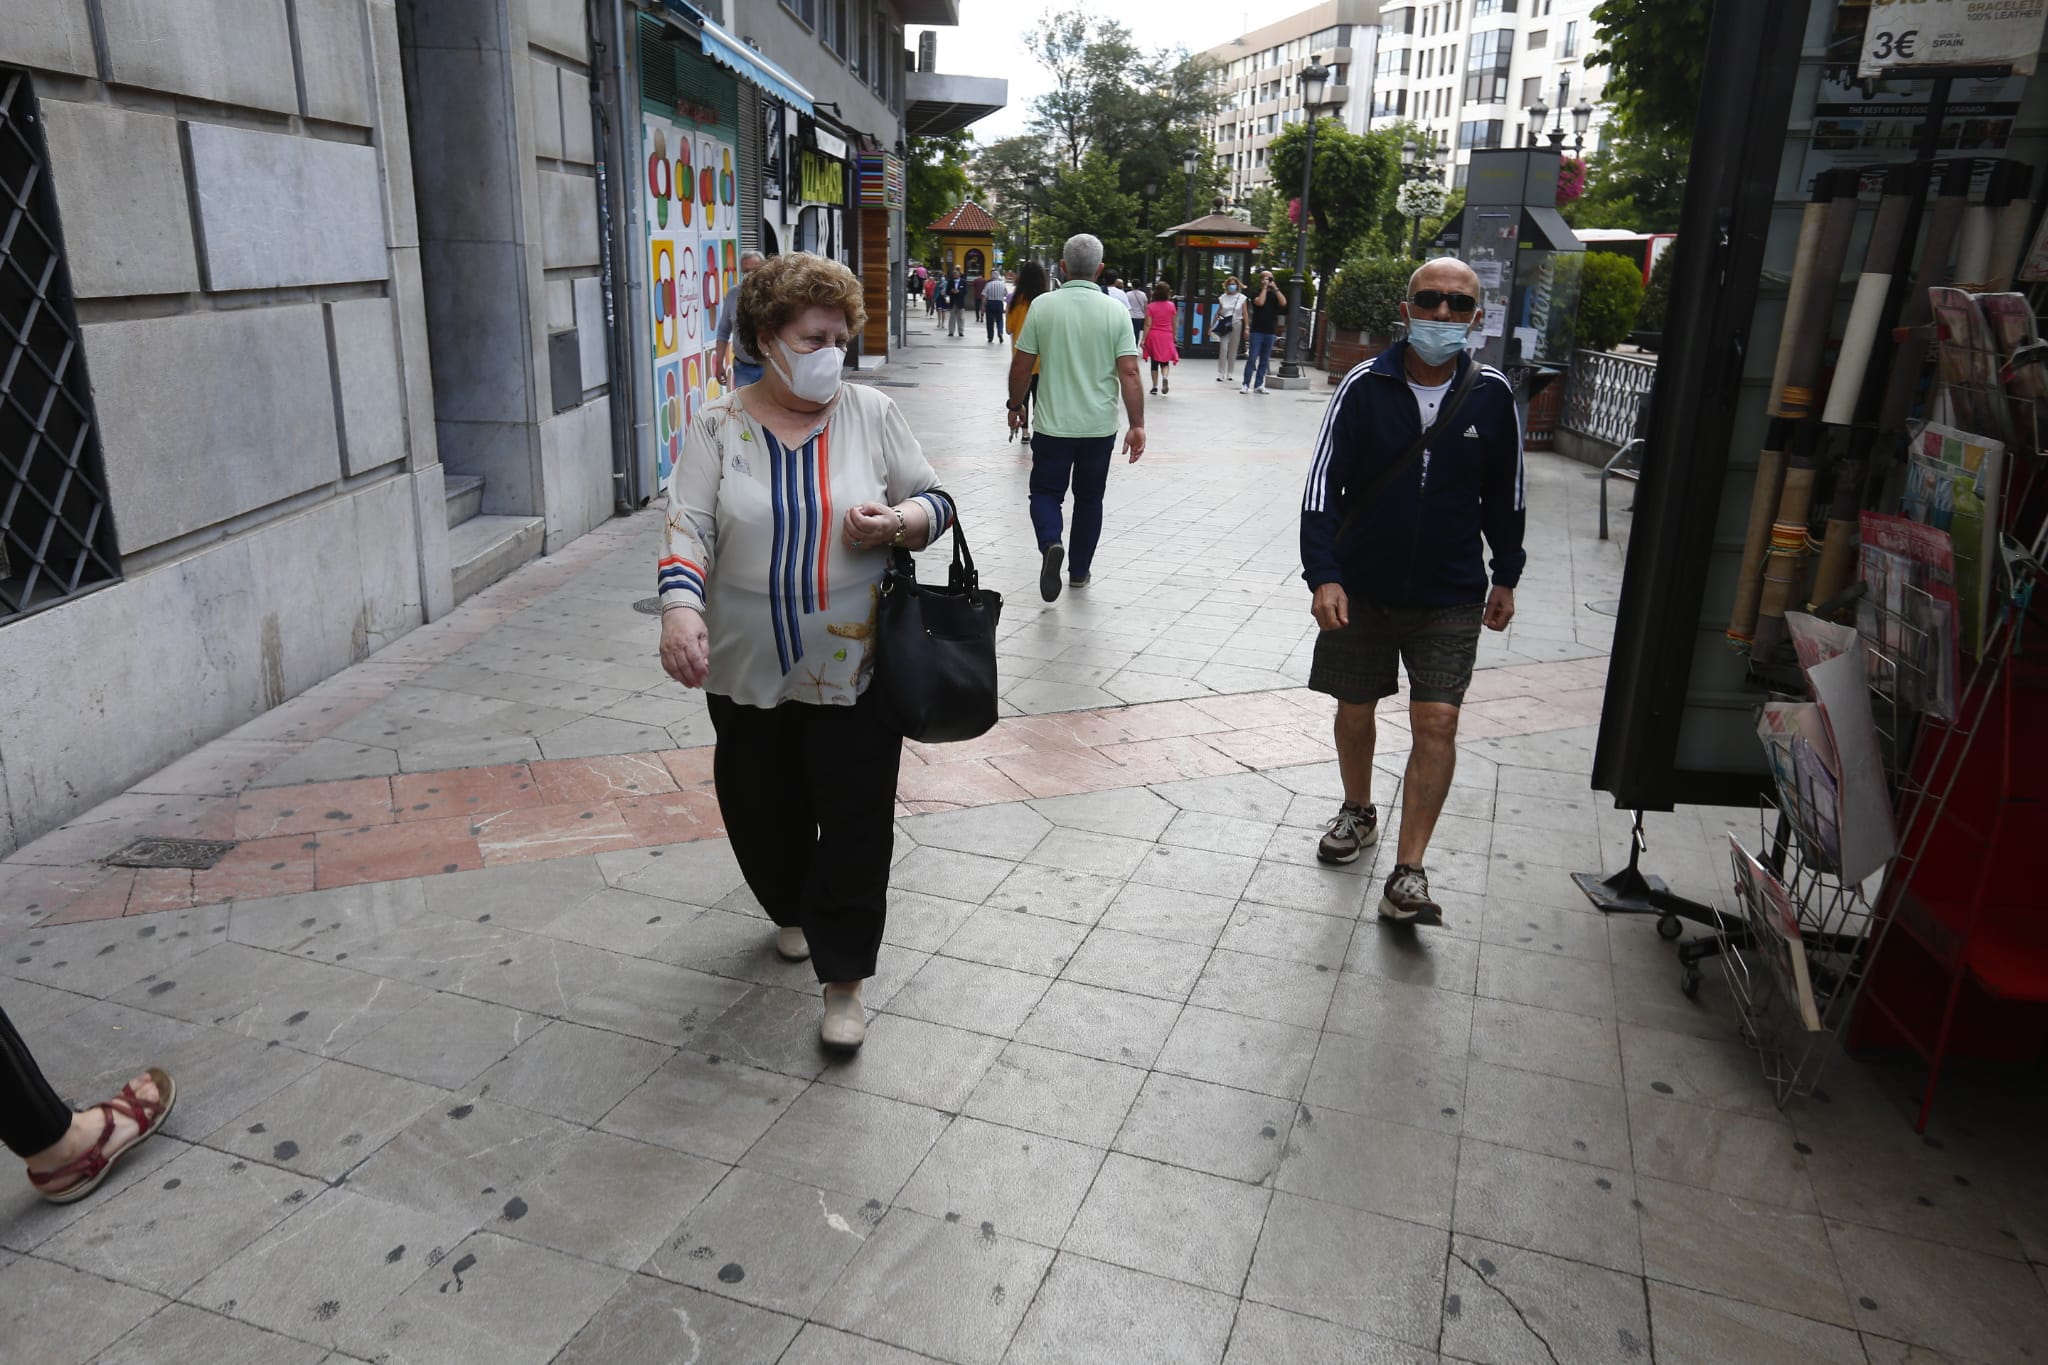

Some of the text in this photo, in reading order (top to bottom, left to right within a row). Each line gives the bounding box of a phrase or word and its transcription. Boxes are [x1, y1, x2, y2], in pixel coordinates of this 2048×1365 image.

[1994, 10, 2042, 20] LEATHER
[1873, 30, 1918, 59] 3€
[1932, 38, 1964, 48] SPAIN
